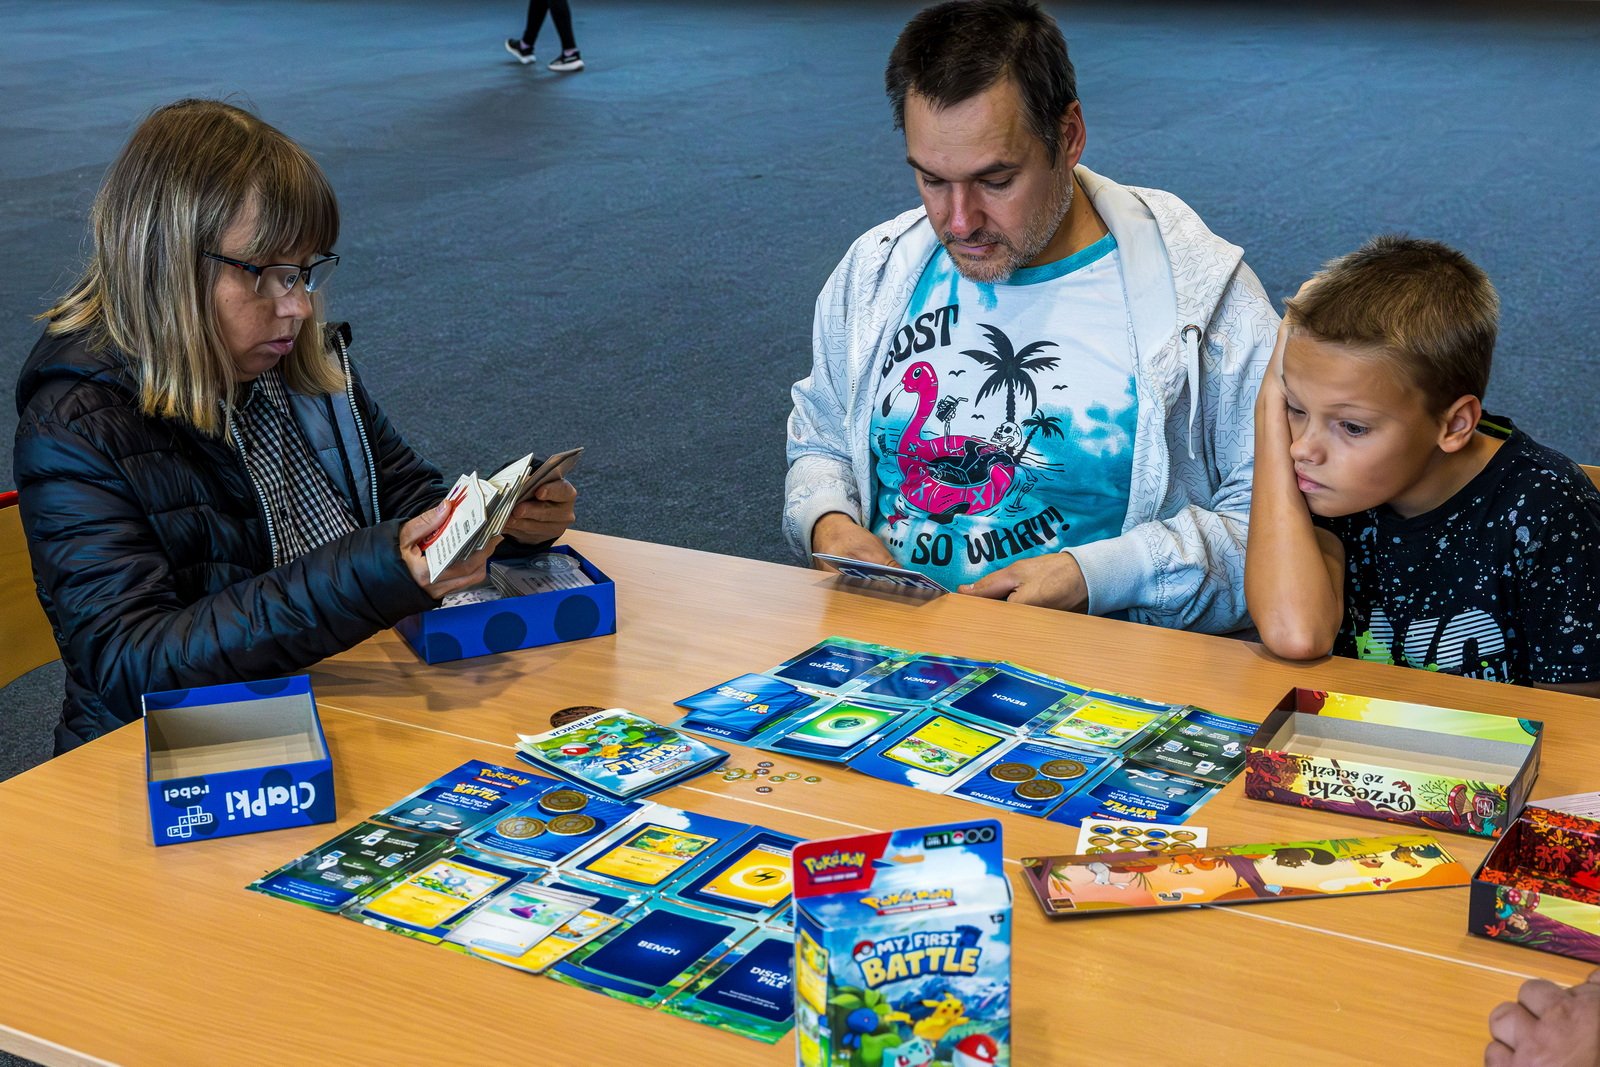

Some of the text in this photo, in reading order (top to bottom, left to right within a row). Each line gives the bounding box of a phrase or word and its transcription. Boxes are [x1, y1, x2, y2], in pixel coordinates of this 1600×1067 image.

[911, 532, 954, 566] SO
[964, 506, 1071, 565] WHAT!
[809, 661, 850, 673] DISCARD
[903, 676, 938, 685] BENCH
[992, 693, 1028, 707] BENCH
[551, 714, 604, 737] INSTRUKCJA
[704, 726, 731, 736] DECK
[604, 744, 681, 773] BATTLE
[1301, 760, 1359, 781] ścieżki
[164, 785, 210, 802] rebel
[452, 785, 501, 801] BATTLE
[970, 791, 1033, 809] PRIZE TOKENS
[1308, 780, 1416, 812] Orzeszki
[1102, 799, 1157, 817] BATTLE
[637, 940, 680, 956] BENCH
[875, 932, 961, 956] MY FIRST
[750, 966, 792, 983] DISCA
[861, 948, 981, 988] BATTLE
[757, 976, 786, 989] PILE
